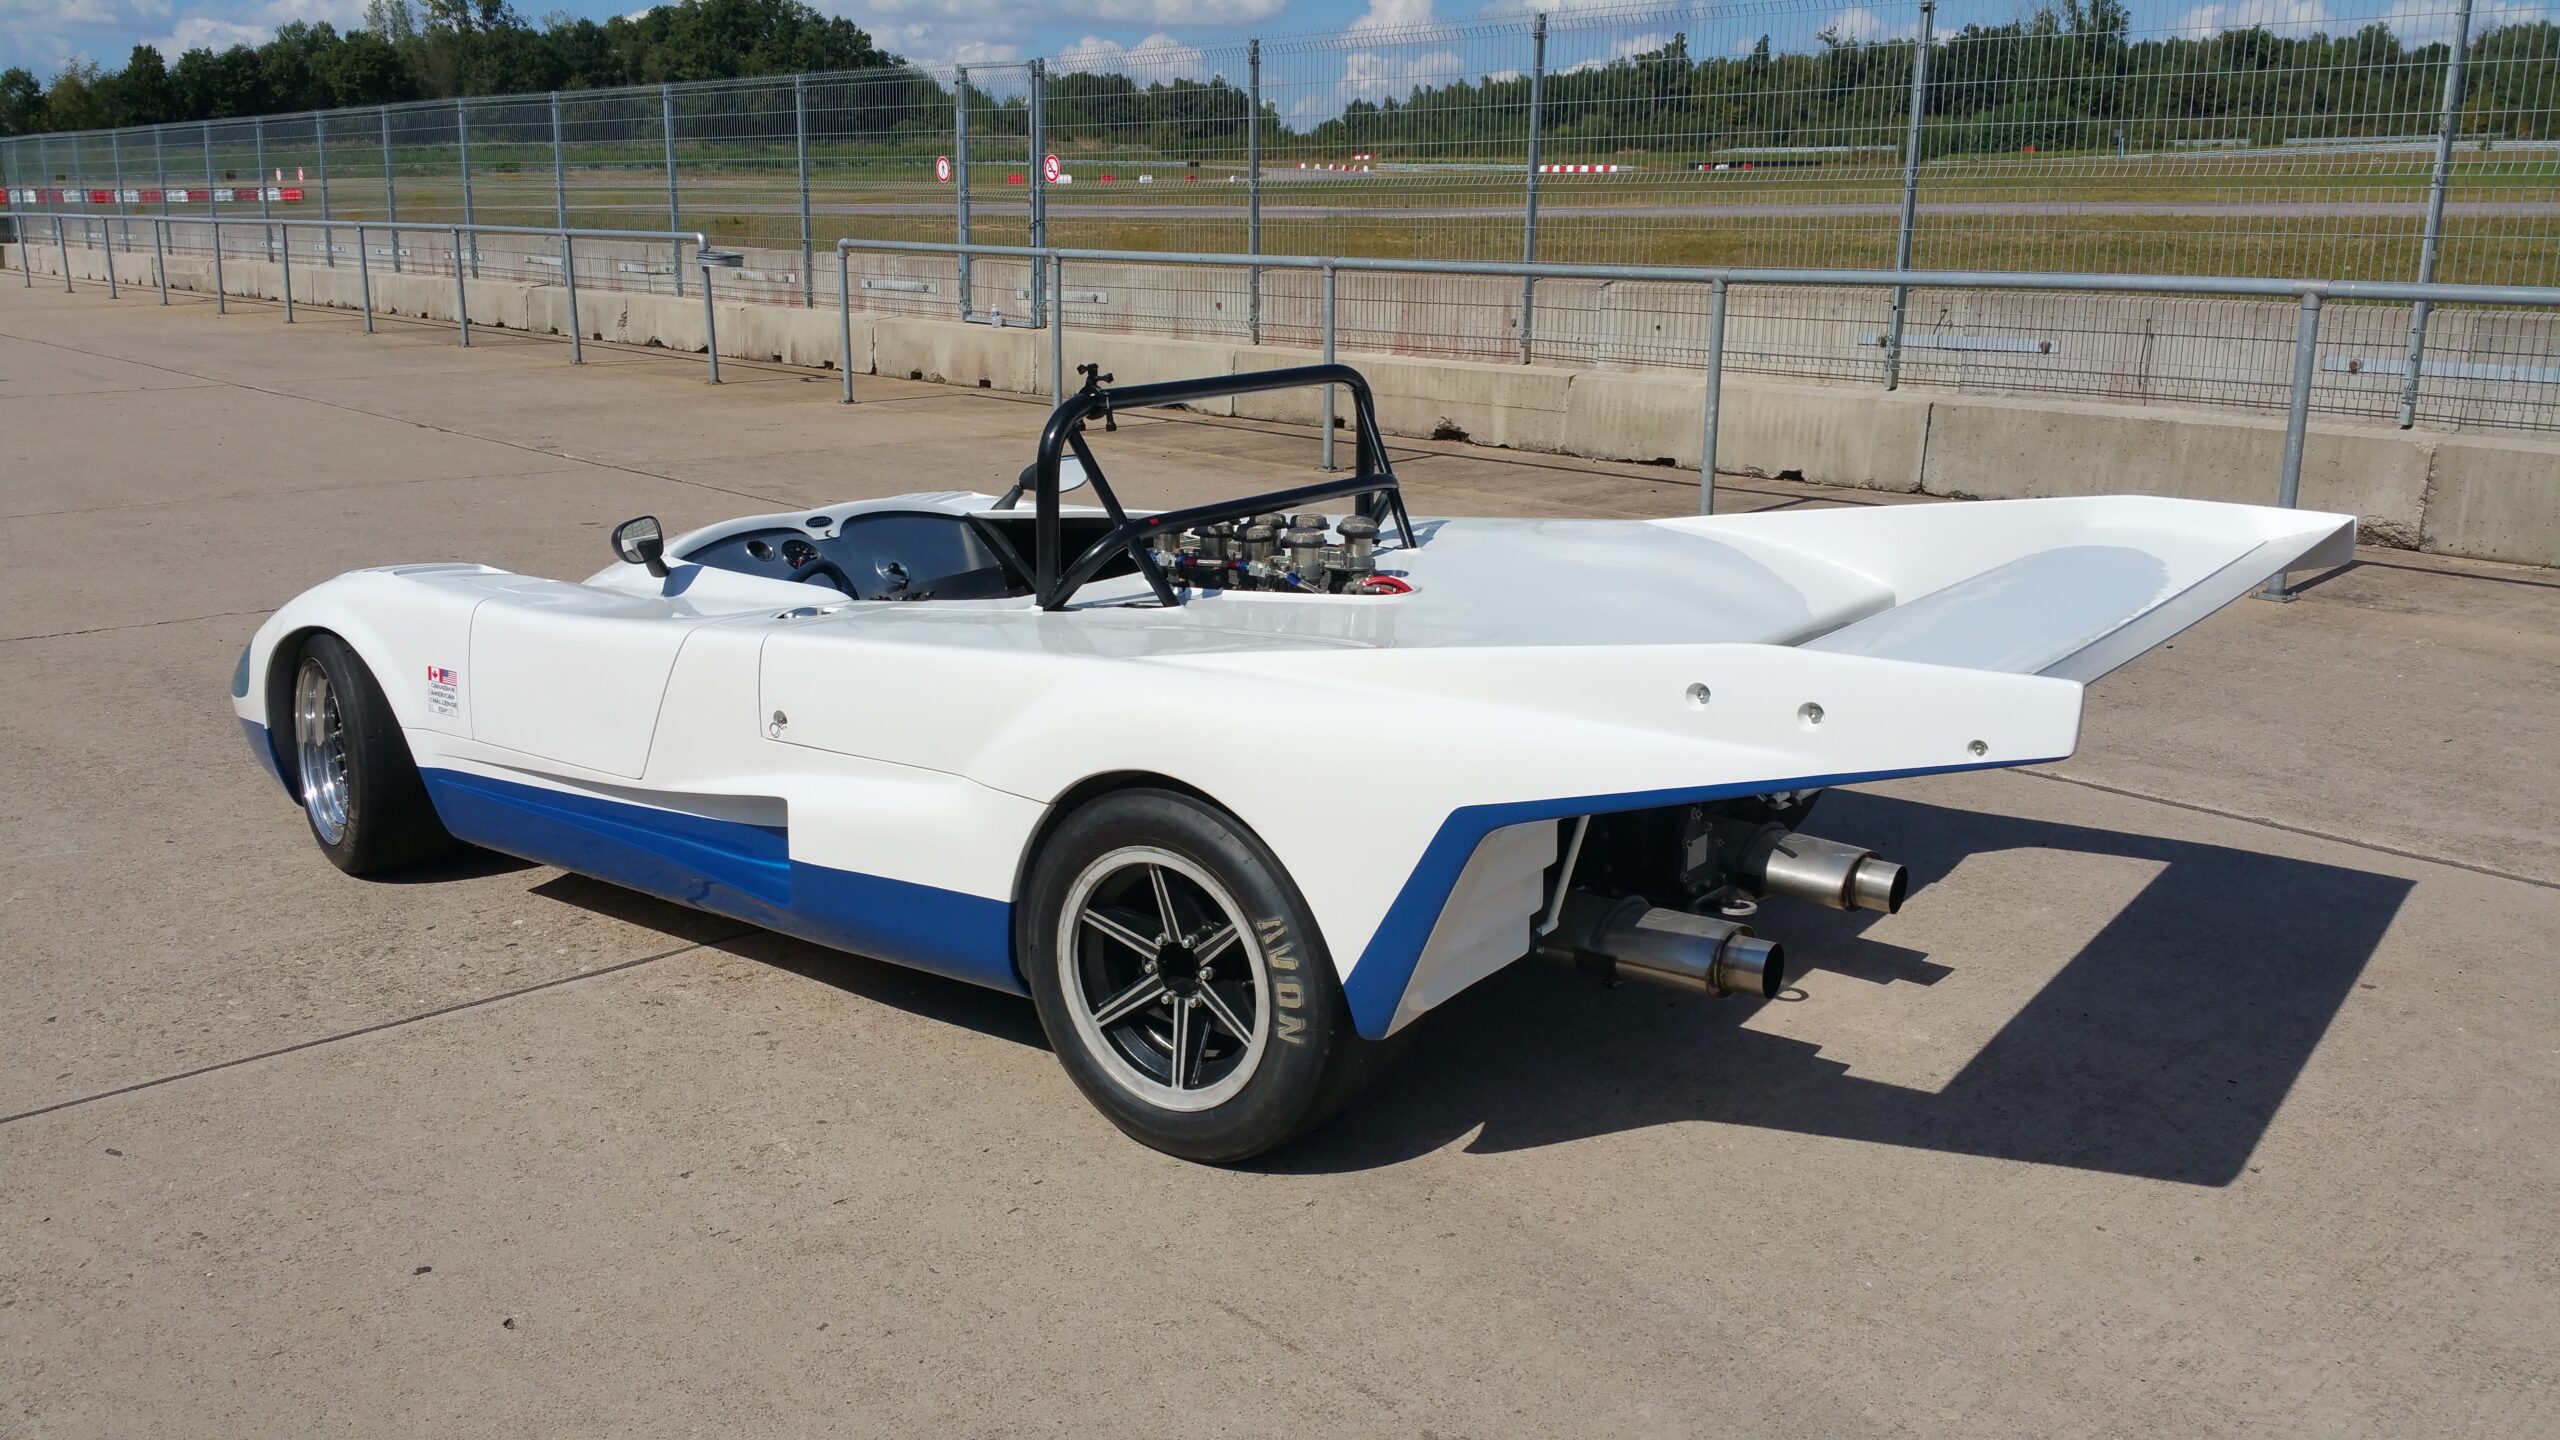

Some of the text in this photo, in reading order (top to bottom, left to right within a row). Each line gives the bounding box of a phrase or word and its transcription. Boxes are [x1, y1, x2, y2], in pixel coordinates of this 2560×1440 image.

[431, 690, 455, 700] AMERICAN
[429, 697, 457, 708] CHALLENGE
[1258, 919, 1305, 1045] AVON
